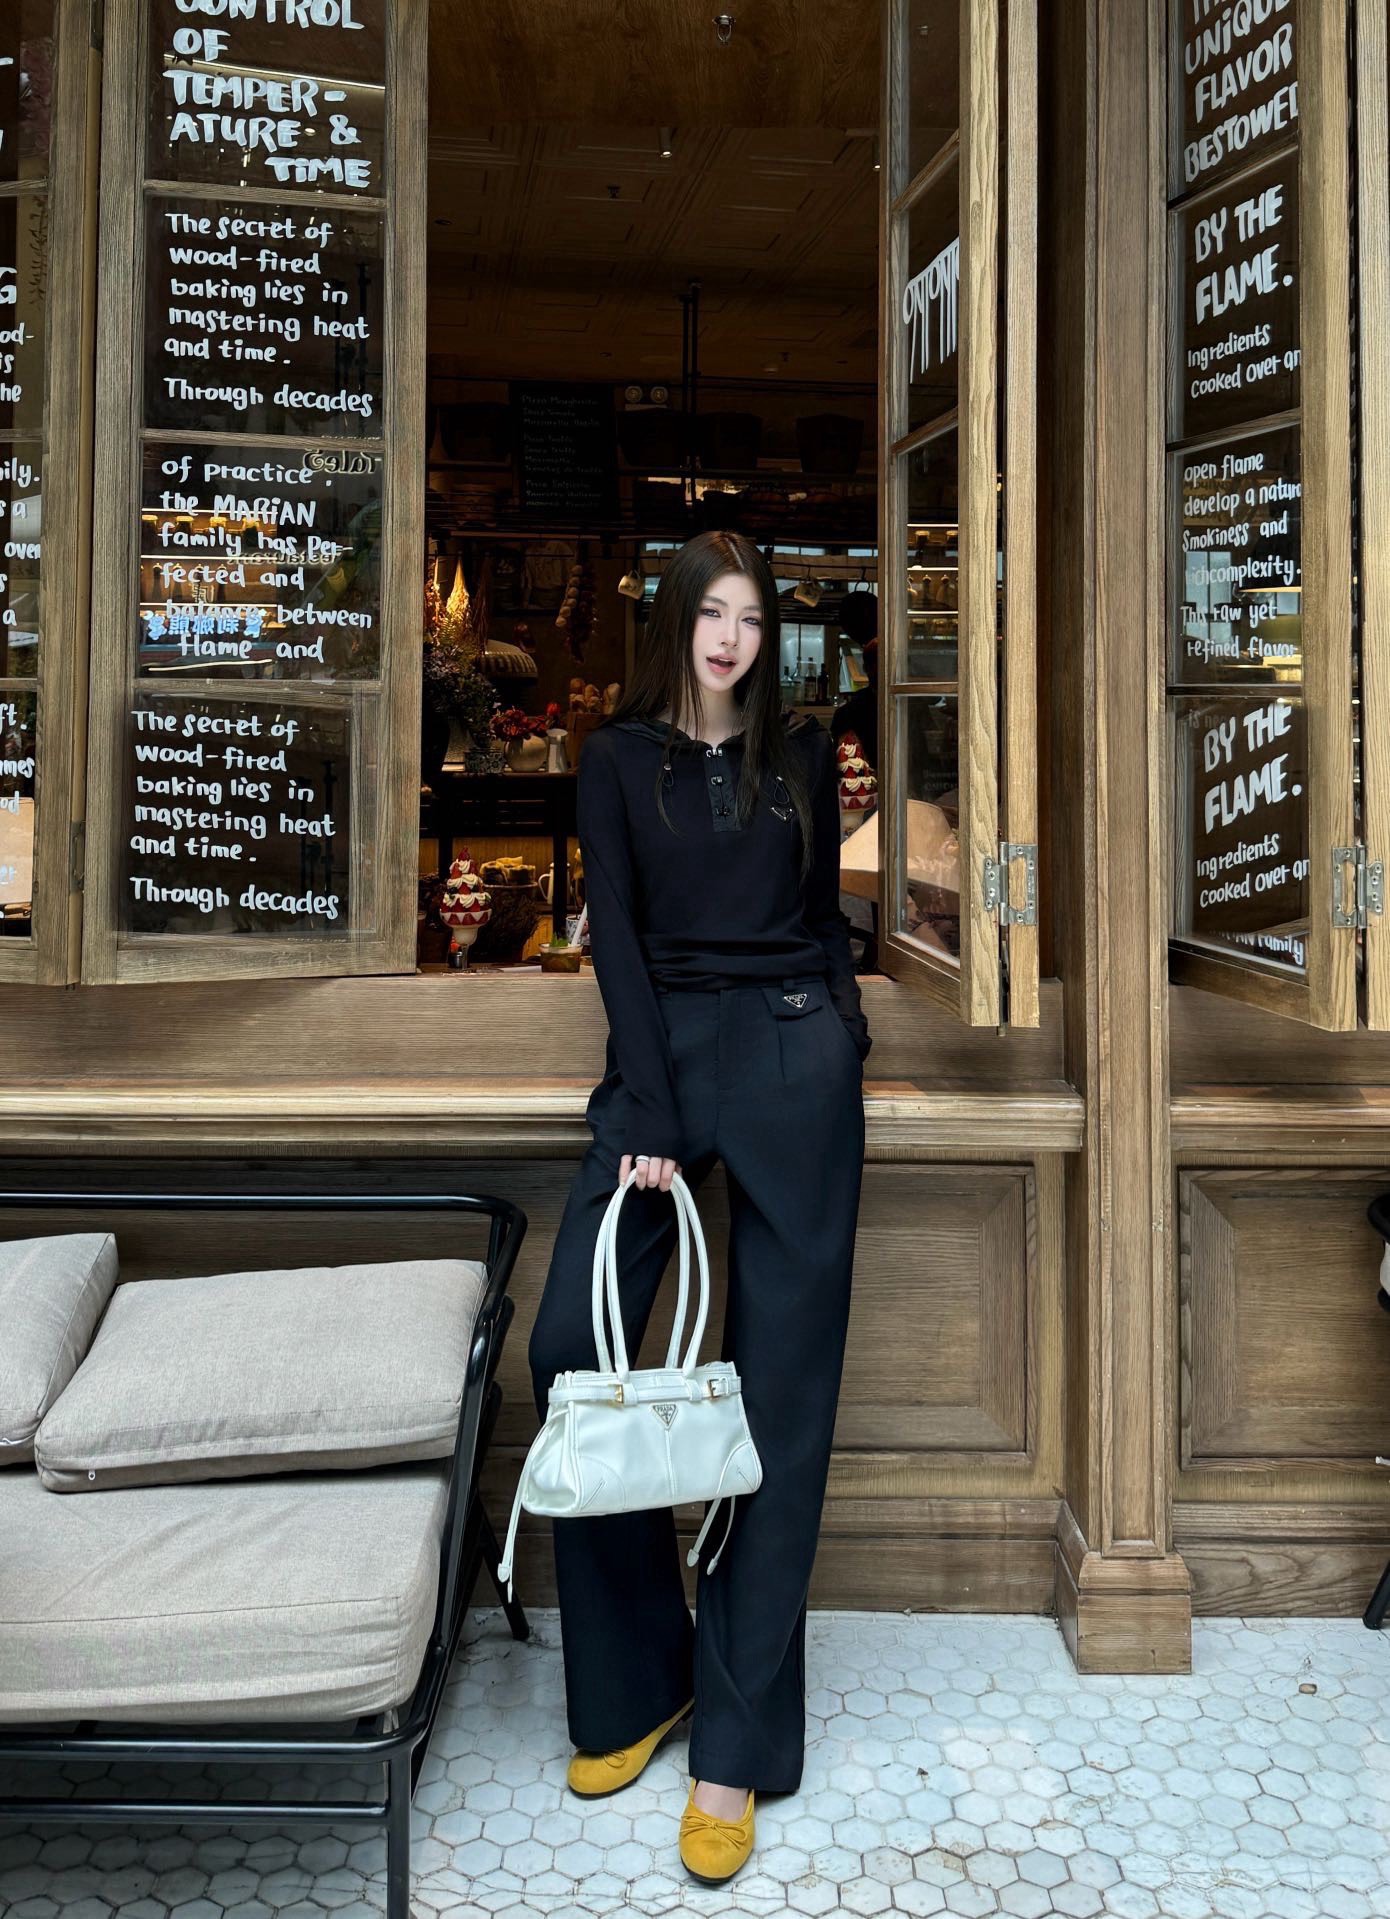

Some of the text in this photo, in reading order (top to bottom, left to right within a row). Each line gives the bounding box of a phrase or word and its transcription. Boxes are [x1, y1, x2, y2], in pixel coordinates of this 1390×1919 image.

[173, 28, 231, 61] OF
[1195, 22, 1293, 123] FLAVOR
[163, 69, 347, 117] TEMPER-
[170, 113, 362, 152] ATURE &
[165, 213, 211, 234] The
[304, 223, 334, 248] of
[1195, 184, 1284, 263] BY THE
[169, 246, 321, 274] wood-fired
[170, 279, 348, 307] baking lies in
[1195, 243, 1293, 325] FLAME.
[169, 307, 370, 342] mastering heat
[164, 338, 210, 359] and
[1188, 323, 1271, 371] Ingredients
[1246, 354, 1282, 383] over
[163, 377, 373, 417] Through decades
[161, 455, 193, 482] of
[1184, 463, 1217, 488] open
[1221, 453, 1264, 481] flame
[160, 491, 199, 516] the
[1184, 492, 1240, 517] develop
[1245, 488, 1255, 507] a
[158, 522, 241, 557] family
[258, 531, 298, 556] has
[1260, 510, 1288, 538] and
[161, 562, 305, 590] fected and
[167, 599, 372, 628] balance between
[1180, 600, 1277, 628] This raw yet
[178, 633, 324, 663] flame and
[1187, 635, 1298, 664] refined flavor
[131, 711, 177, 731] The
[270, 720, 300, 745] of
[1204, 702, 1292, 773] BY THE
[135, 743, 287, 772] wood-fired
[136, 776, 314, 804] baking lies in
[1204, 753, 1302, 835] FLAME.
[135, 805, 336, 839] mastering heat
[130, 836, 176, 856] and
[1196, 833, 1280, 880] Ingredients
[1255, 865, 1290, 892] over
[129, 877, 339, 920] Through decades
